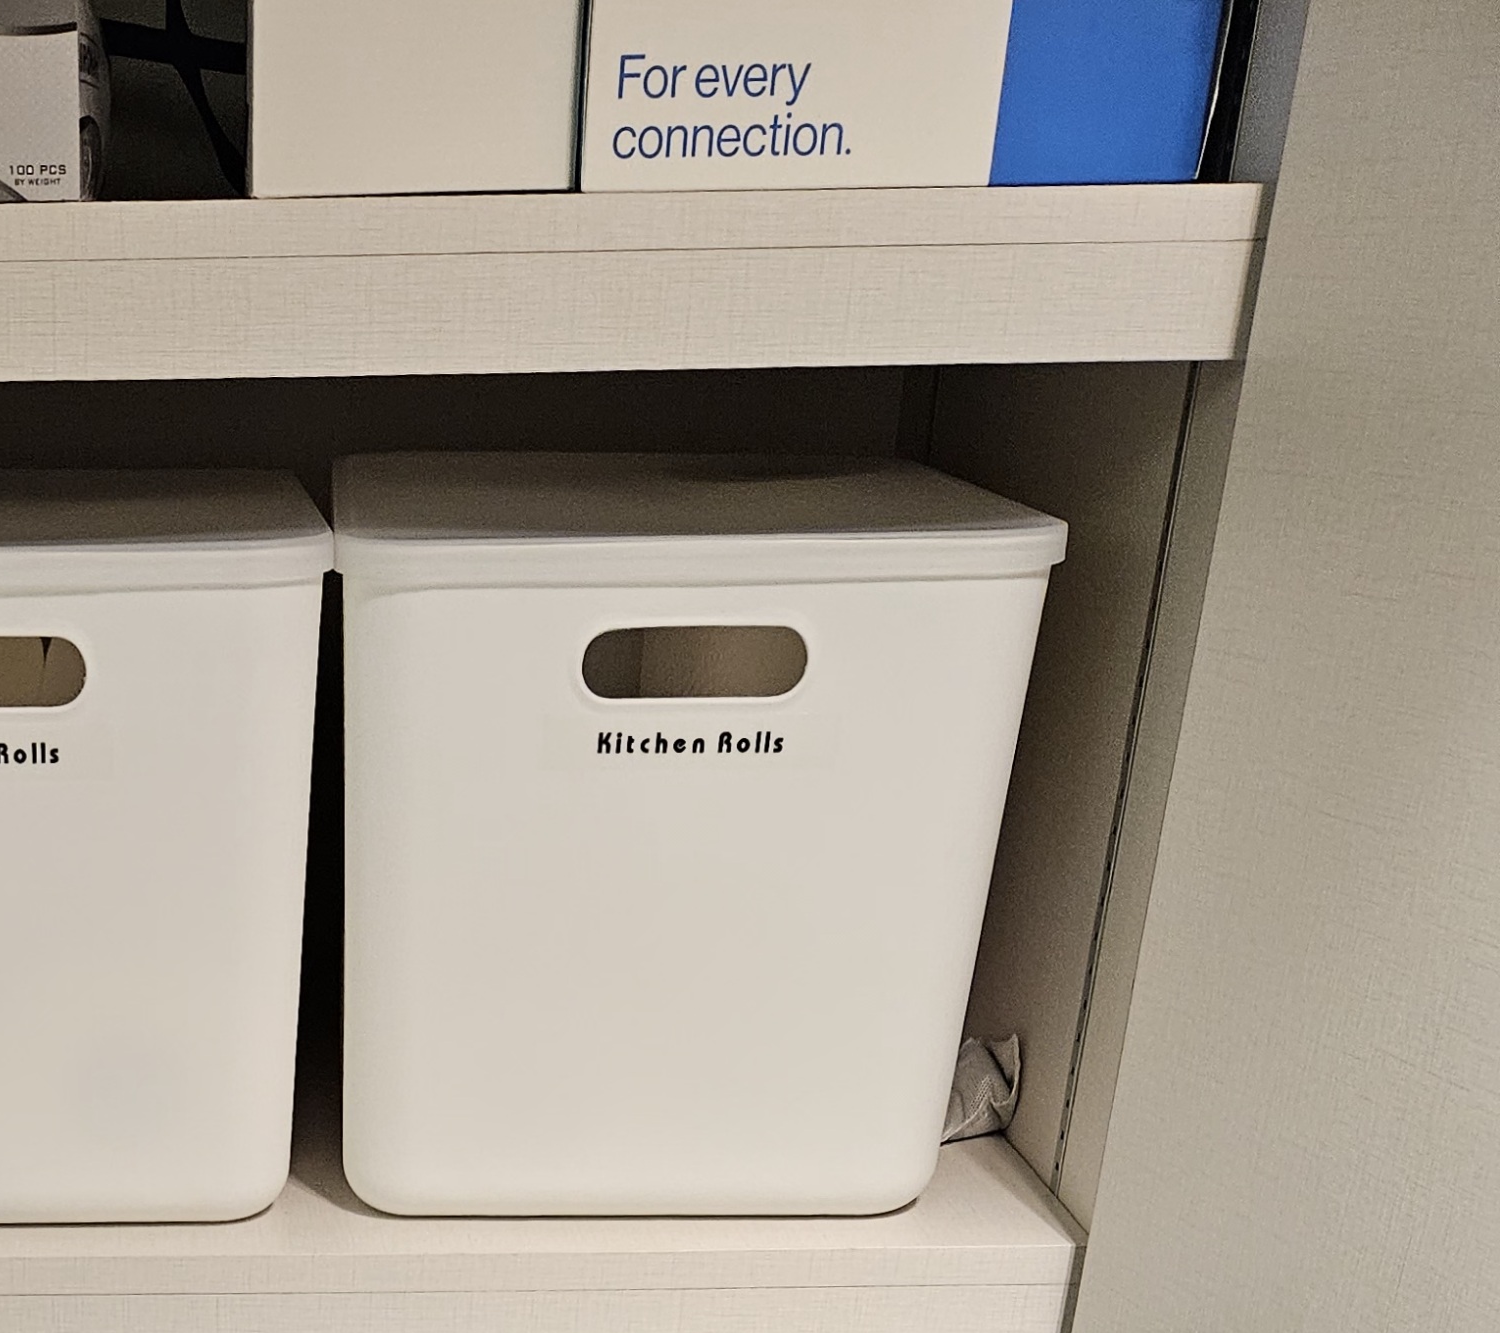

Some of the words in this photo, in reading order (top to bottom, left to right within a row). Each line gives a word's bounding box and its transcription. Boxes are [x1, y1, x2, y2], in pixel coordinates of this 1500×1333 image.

[618, 53, 688, 99] For
[694, 62, 812, 106] every
[612, 112, 852, 160] connection.
[9, 165, 34, 175] 100
[39, 165, 67, 175] PCS
[28, 178, 61, 186] WEIGHT
[597, 732, 705, 753] Kitchen
[717, 731, 784, 753] Rolls
